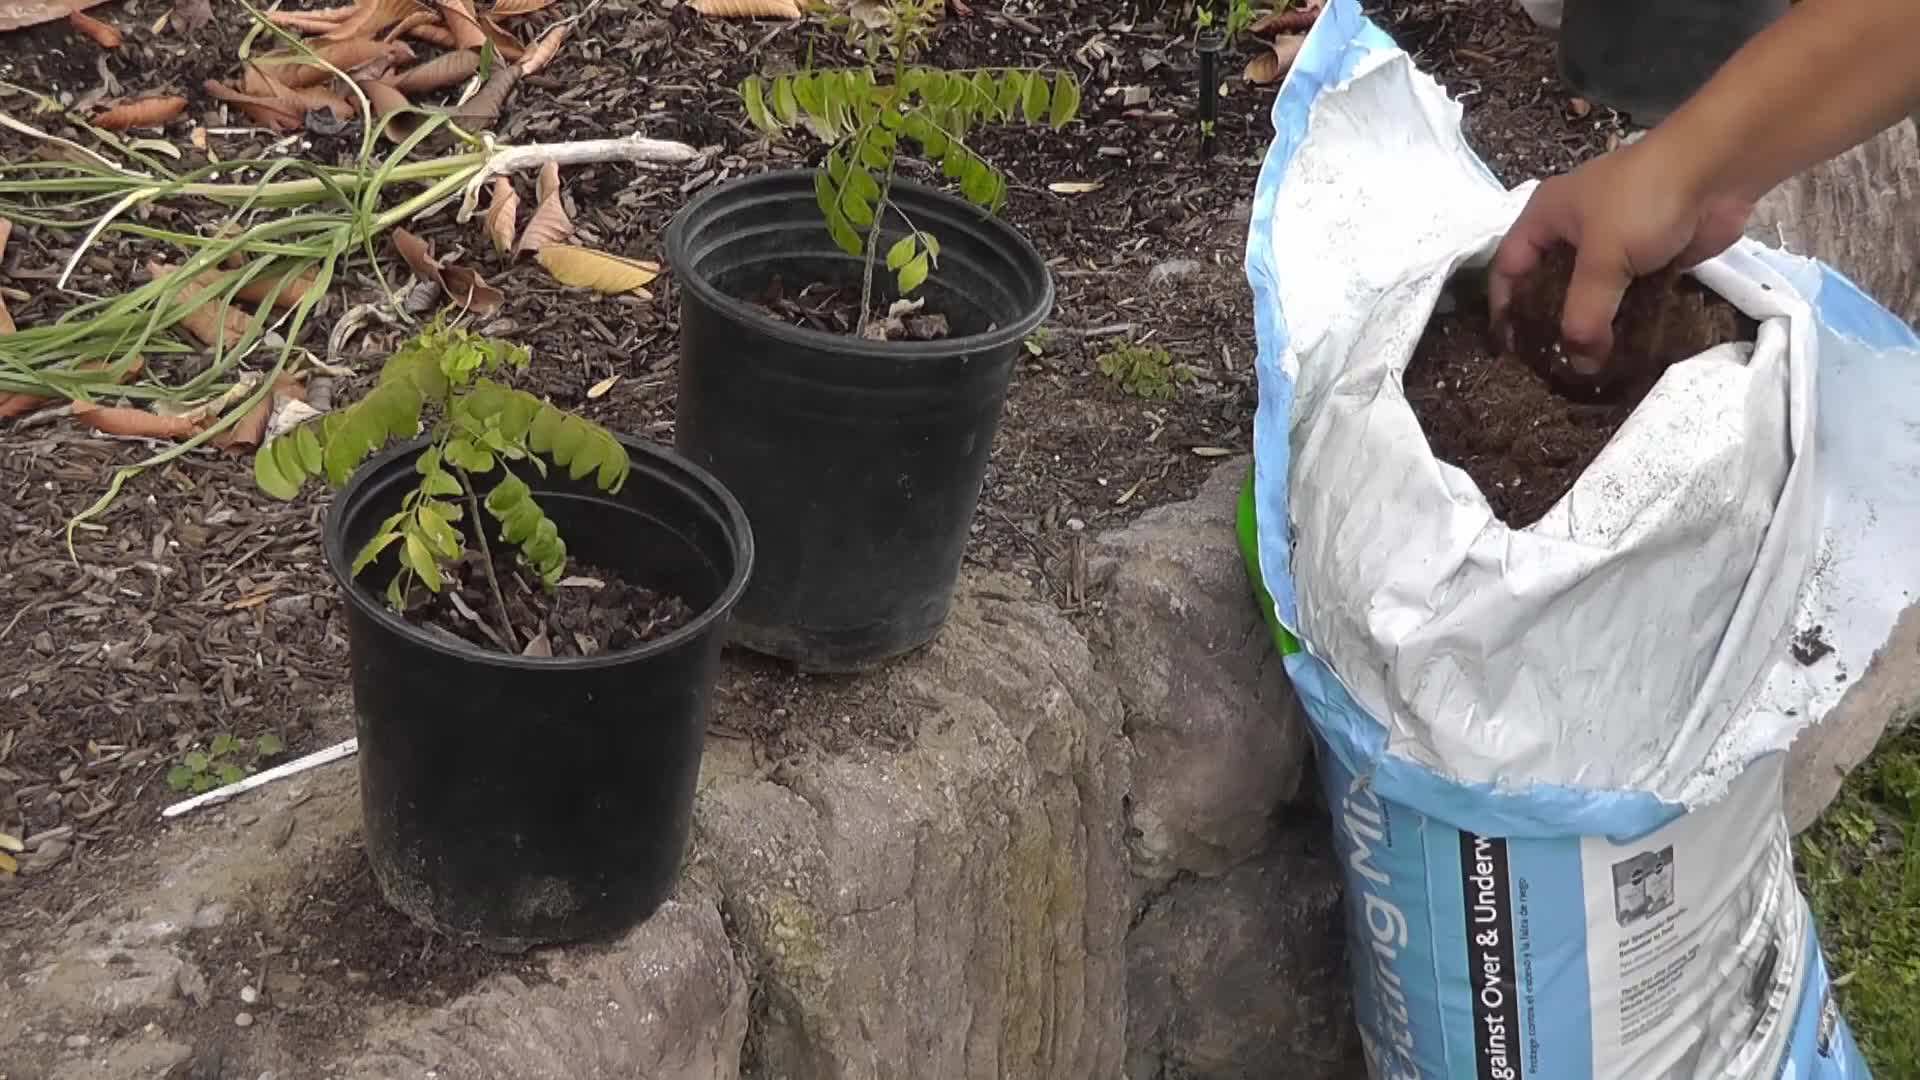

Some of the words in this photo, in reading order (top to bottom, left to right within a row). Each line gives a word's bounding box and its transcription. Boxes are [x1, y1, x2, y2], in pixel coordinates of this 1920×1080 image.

[1343, 777, 1391, 887] Mix
[1475, 928, 1499, 947] &
[1481, 951, 1503, 1008] Over
